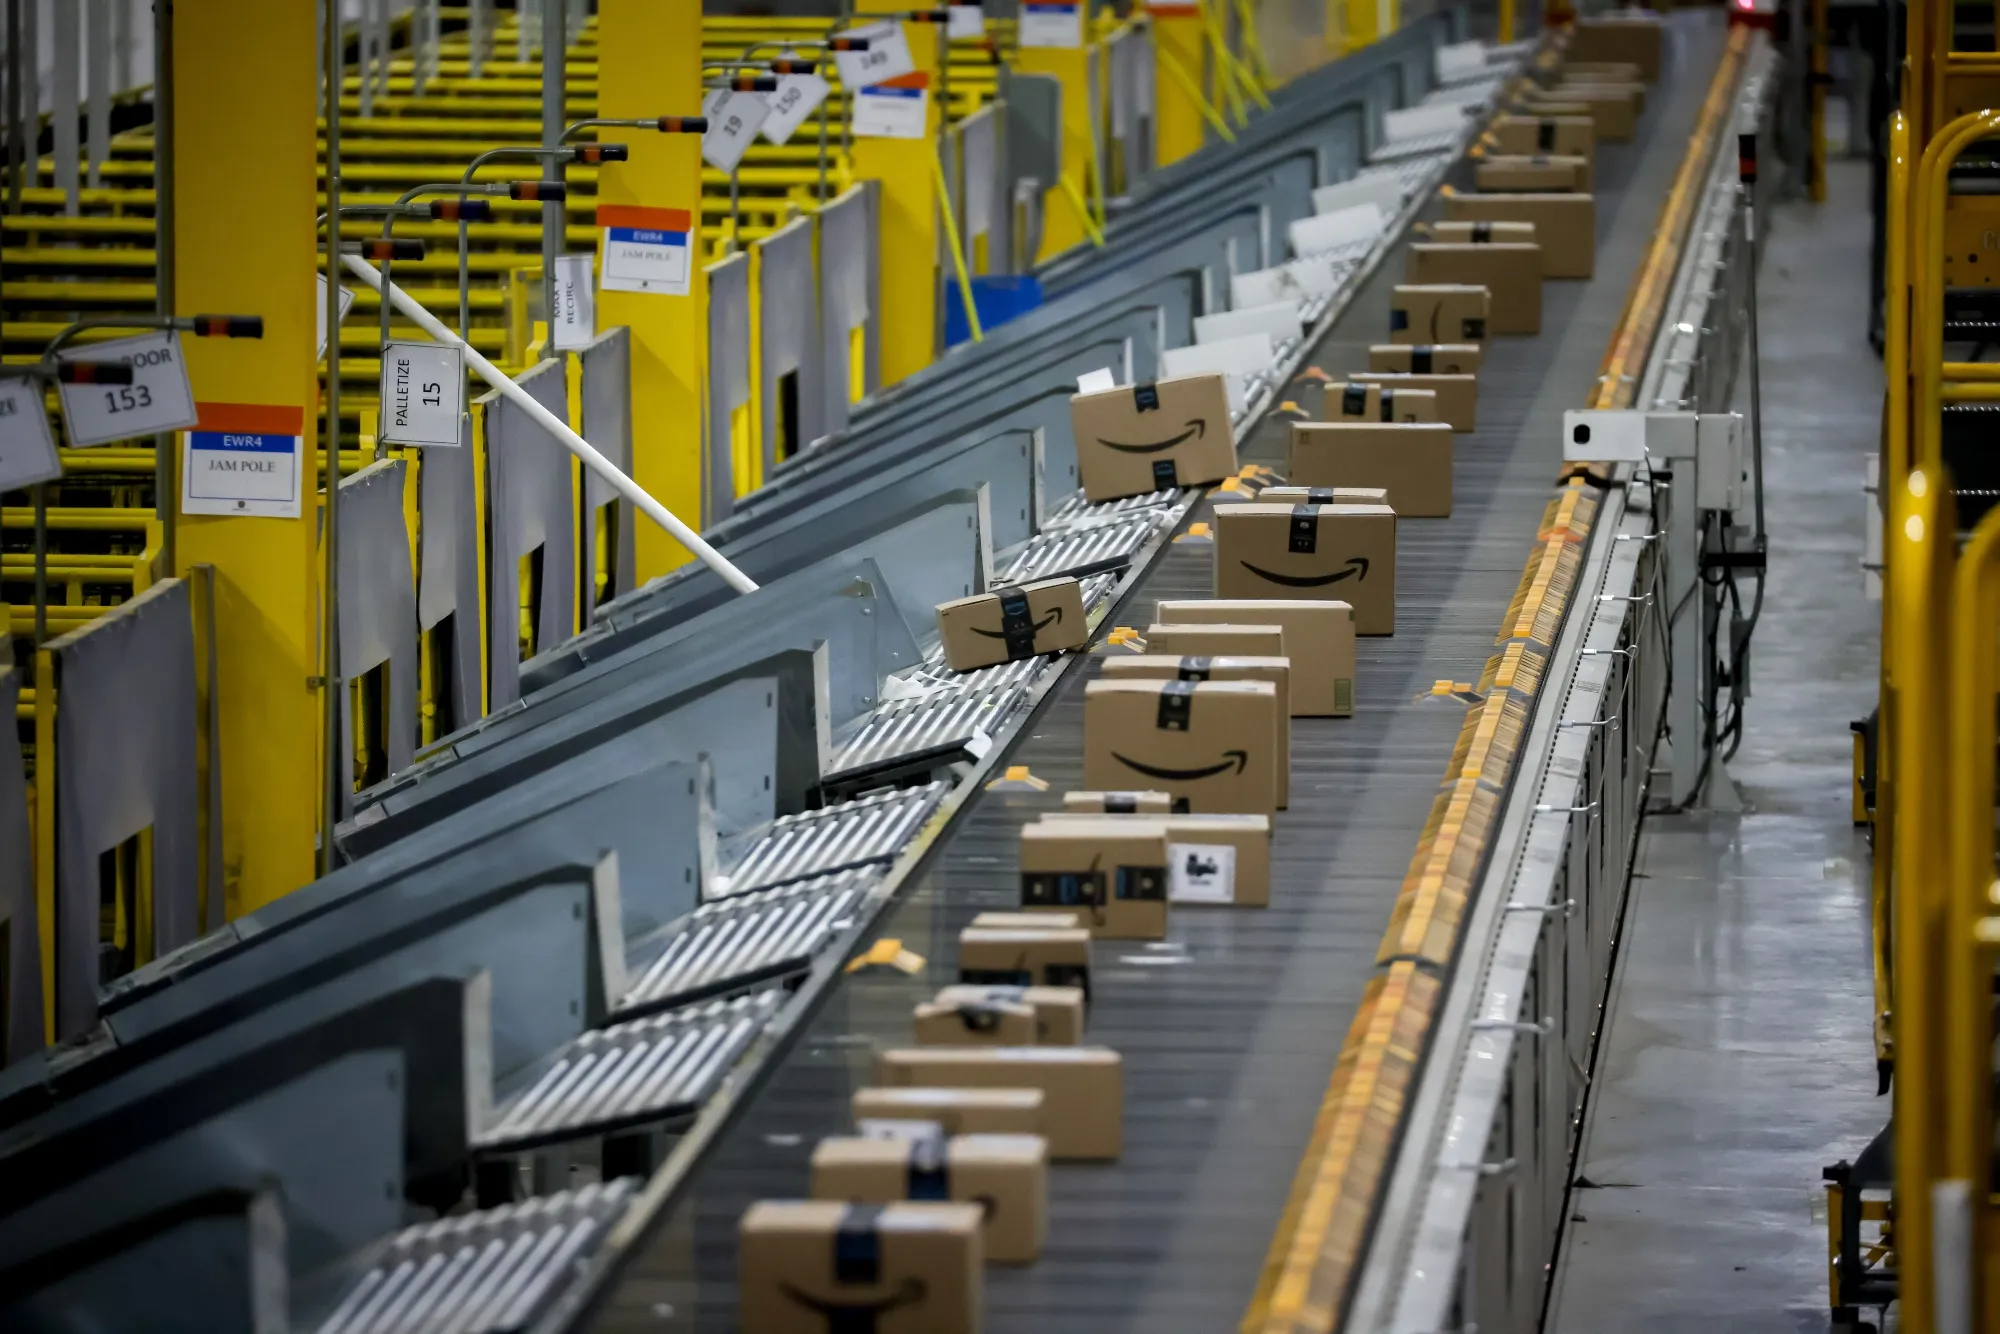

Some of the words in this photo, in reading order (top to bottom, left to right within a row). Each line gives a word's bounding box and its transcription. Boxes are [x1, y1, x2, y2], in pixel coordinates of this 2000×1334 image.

[775, 86, 802, 115] 150
[723, 115, 743, 137] 19
[633, 231, 663, 241] EWR4
[622, 250, 643, 259] JAM
[105, 385, 153, 414] 153
[396, 359, 410, 426] PALLETIZE
[423, 383, 441, 407] 15
[223, 435, 263, 447] EWR4
[208, 459, 237, 472] JAM
[241, 461, 276, 473] POLE
